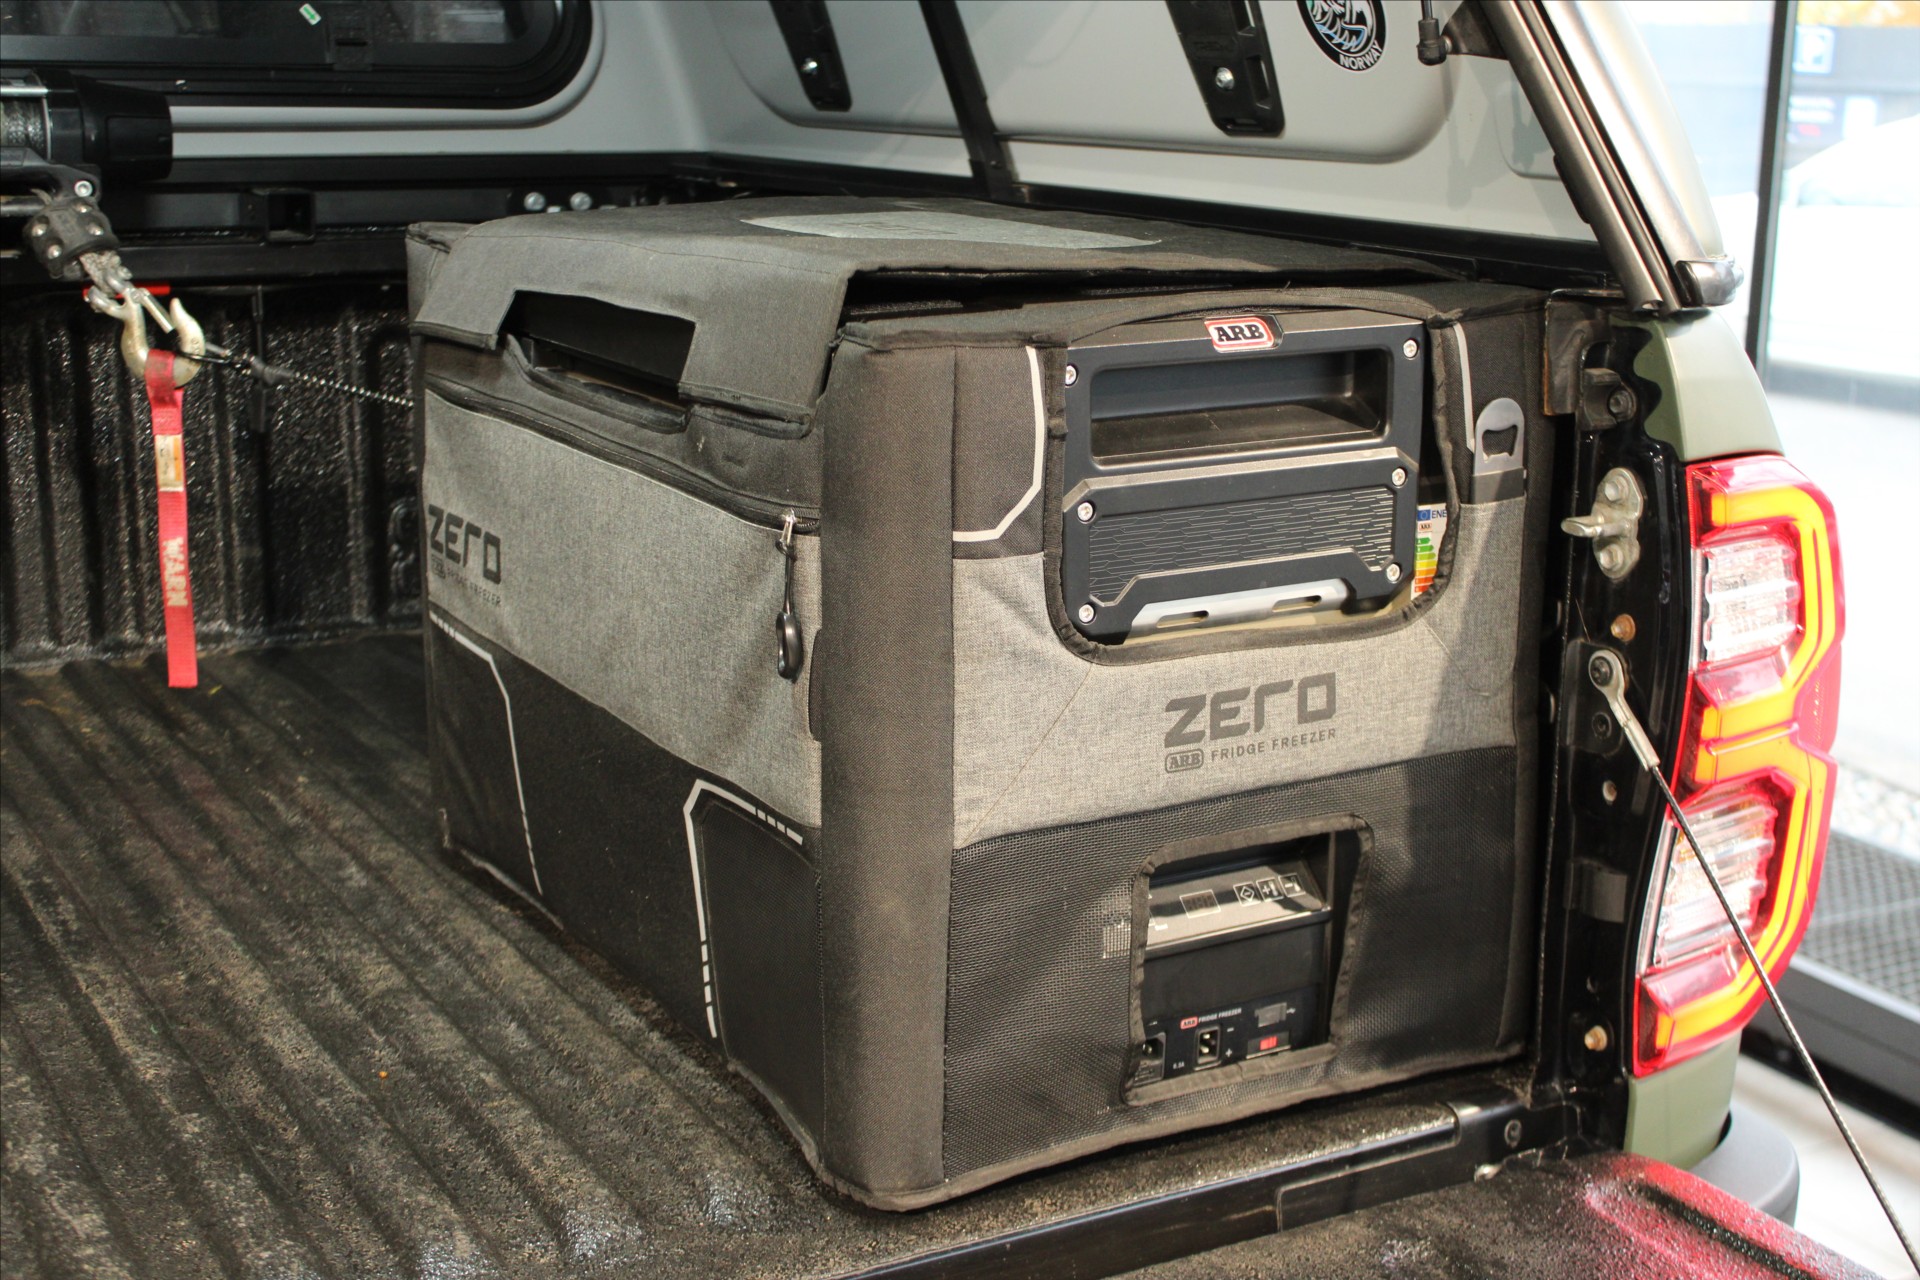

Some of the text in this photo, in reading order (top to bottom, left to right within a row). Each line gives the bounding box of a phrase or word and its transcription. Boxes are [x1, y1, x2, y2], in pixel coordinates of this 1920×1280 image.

[1339, 40, 1382, 70] NORWAY
[1213, 323, 1265, 342] ARB
[162, 536, 189, 607] WARN
[1168, 728, 1337, 771] ARB FRIDGE FREEZER
[1198, 1013, 1218, 1023] FRIDGE
[1218, 1007, 1242, 1019] FREEZER
